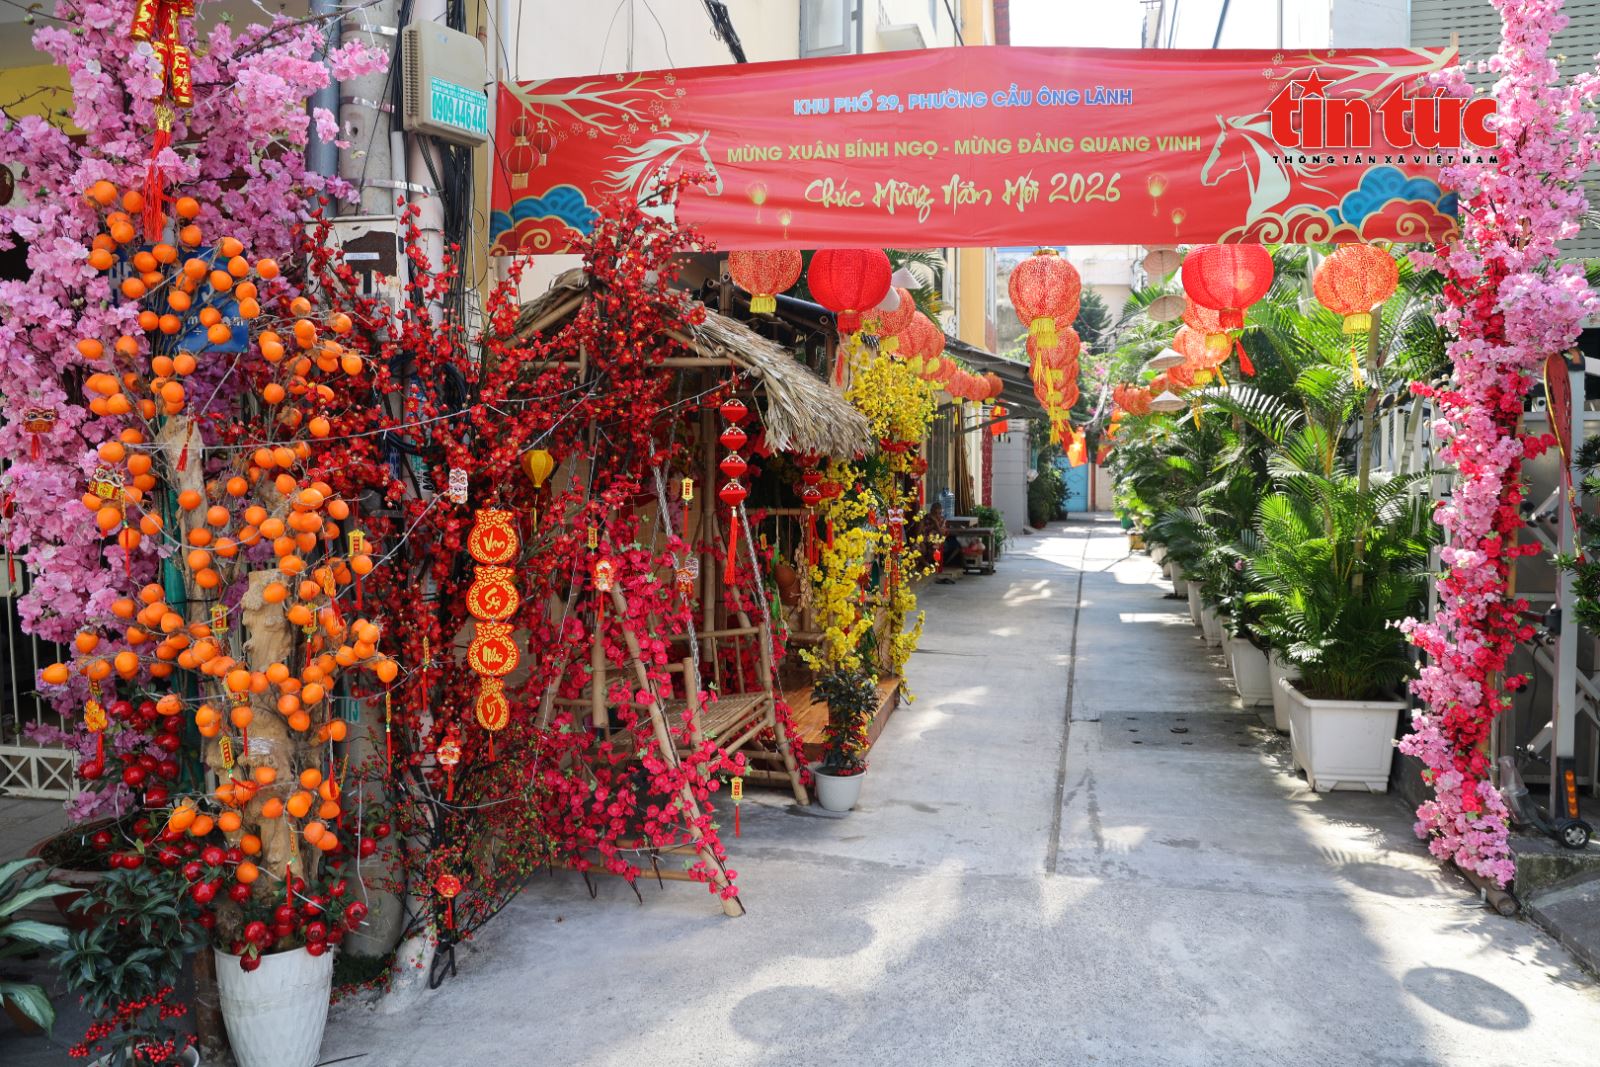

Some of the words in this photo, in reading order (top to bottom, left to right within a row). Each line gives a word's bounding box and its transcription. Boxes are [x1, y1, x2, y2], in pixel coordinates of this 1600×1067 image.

[793, 98, 830, 116] KHU
[834, 89, 874, 113] PHỐ
[876, 94, 905, 113] 29,
[908, 88, 988, 110] PHƯỜNG
[992, 82, 1033, 107] CẦU
[1036, 85, 1081, 106] ÔNG
[1084, 85, 1133, 106] LÃNH
[727, 143, 783, 162] MỪNG
[788, 140, 840, 160] XUÂN
[845, 138, 889, 158] BÍNH
[894, 140, 938, 160] NGỌ
[954, 135, 1012, 155] MỪNG
[1018, 132, 1075, 153] ĐẢNG
[1080, 136, 1151, 152] QUANG
[1156, 135, 1201, 152] VINH
[804, 177, 864, 208] Chúc
[872, 178, 935, 224] Mừng
[941, 173, 993, 216] Năm
[1001, 169, 1040, 212] Mới
[1048, 172, 1121, 203] 2026
